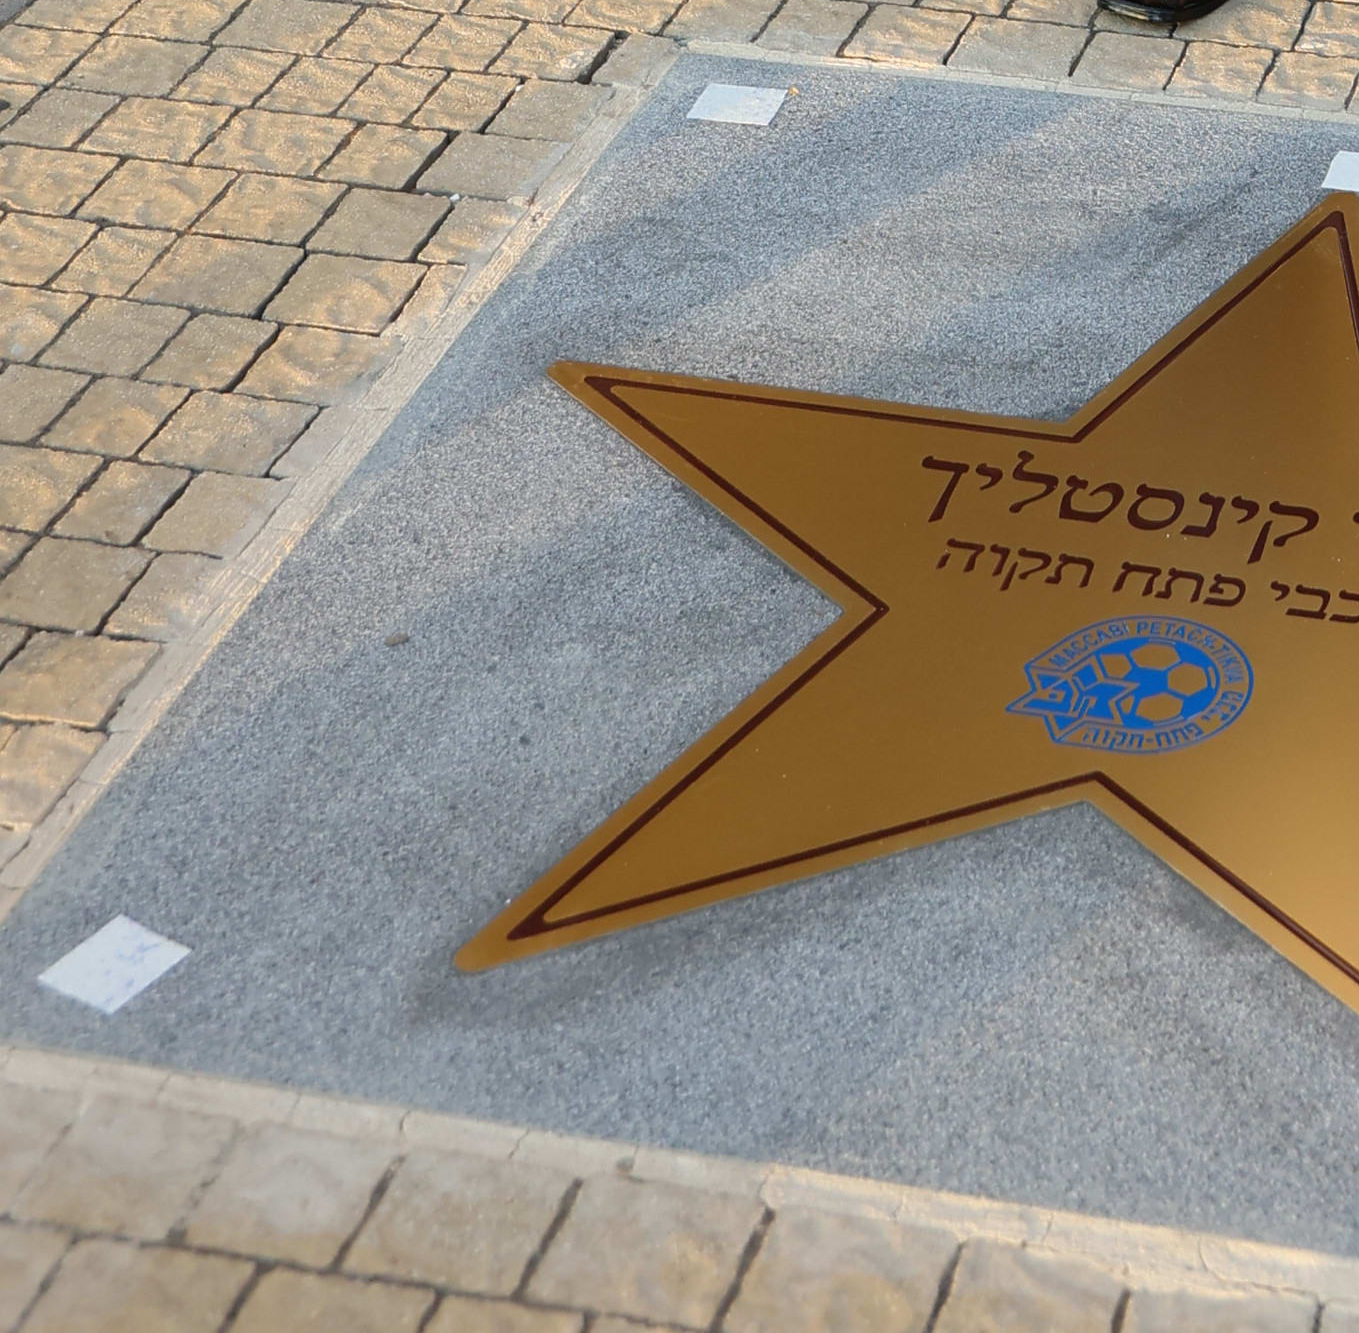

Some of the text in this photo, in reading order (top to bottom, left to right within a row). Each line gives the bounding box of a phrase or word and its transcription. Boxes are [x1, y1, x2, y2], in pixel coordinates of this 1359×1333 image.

[921, 450, 1319, 565] קינסטליך
[936, 538, 1095, 591] תקוה
[1112, 561, 1246, 607] פתח
[1048, 620, 1129, 669] MACCABI
